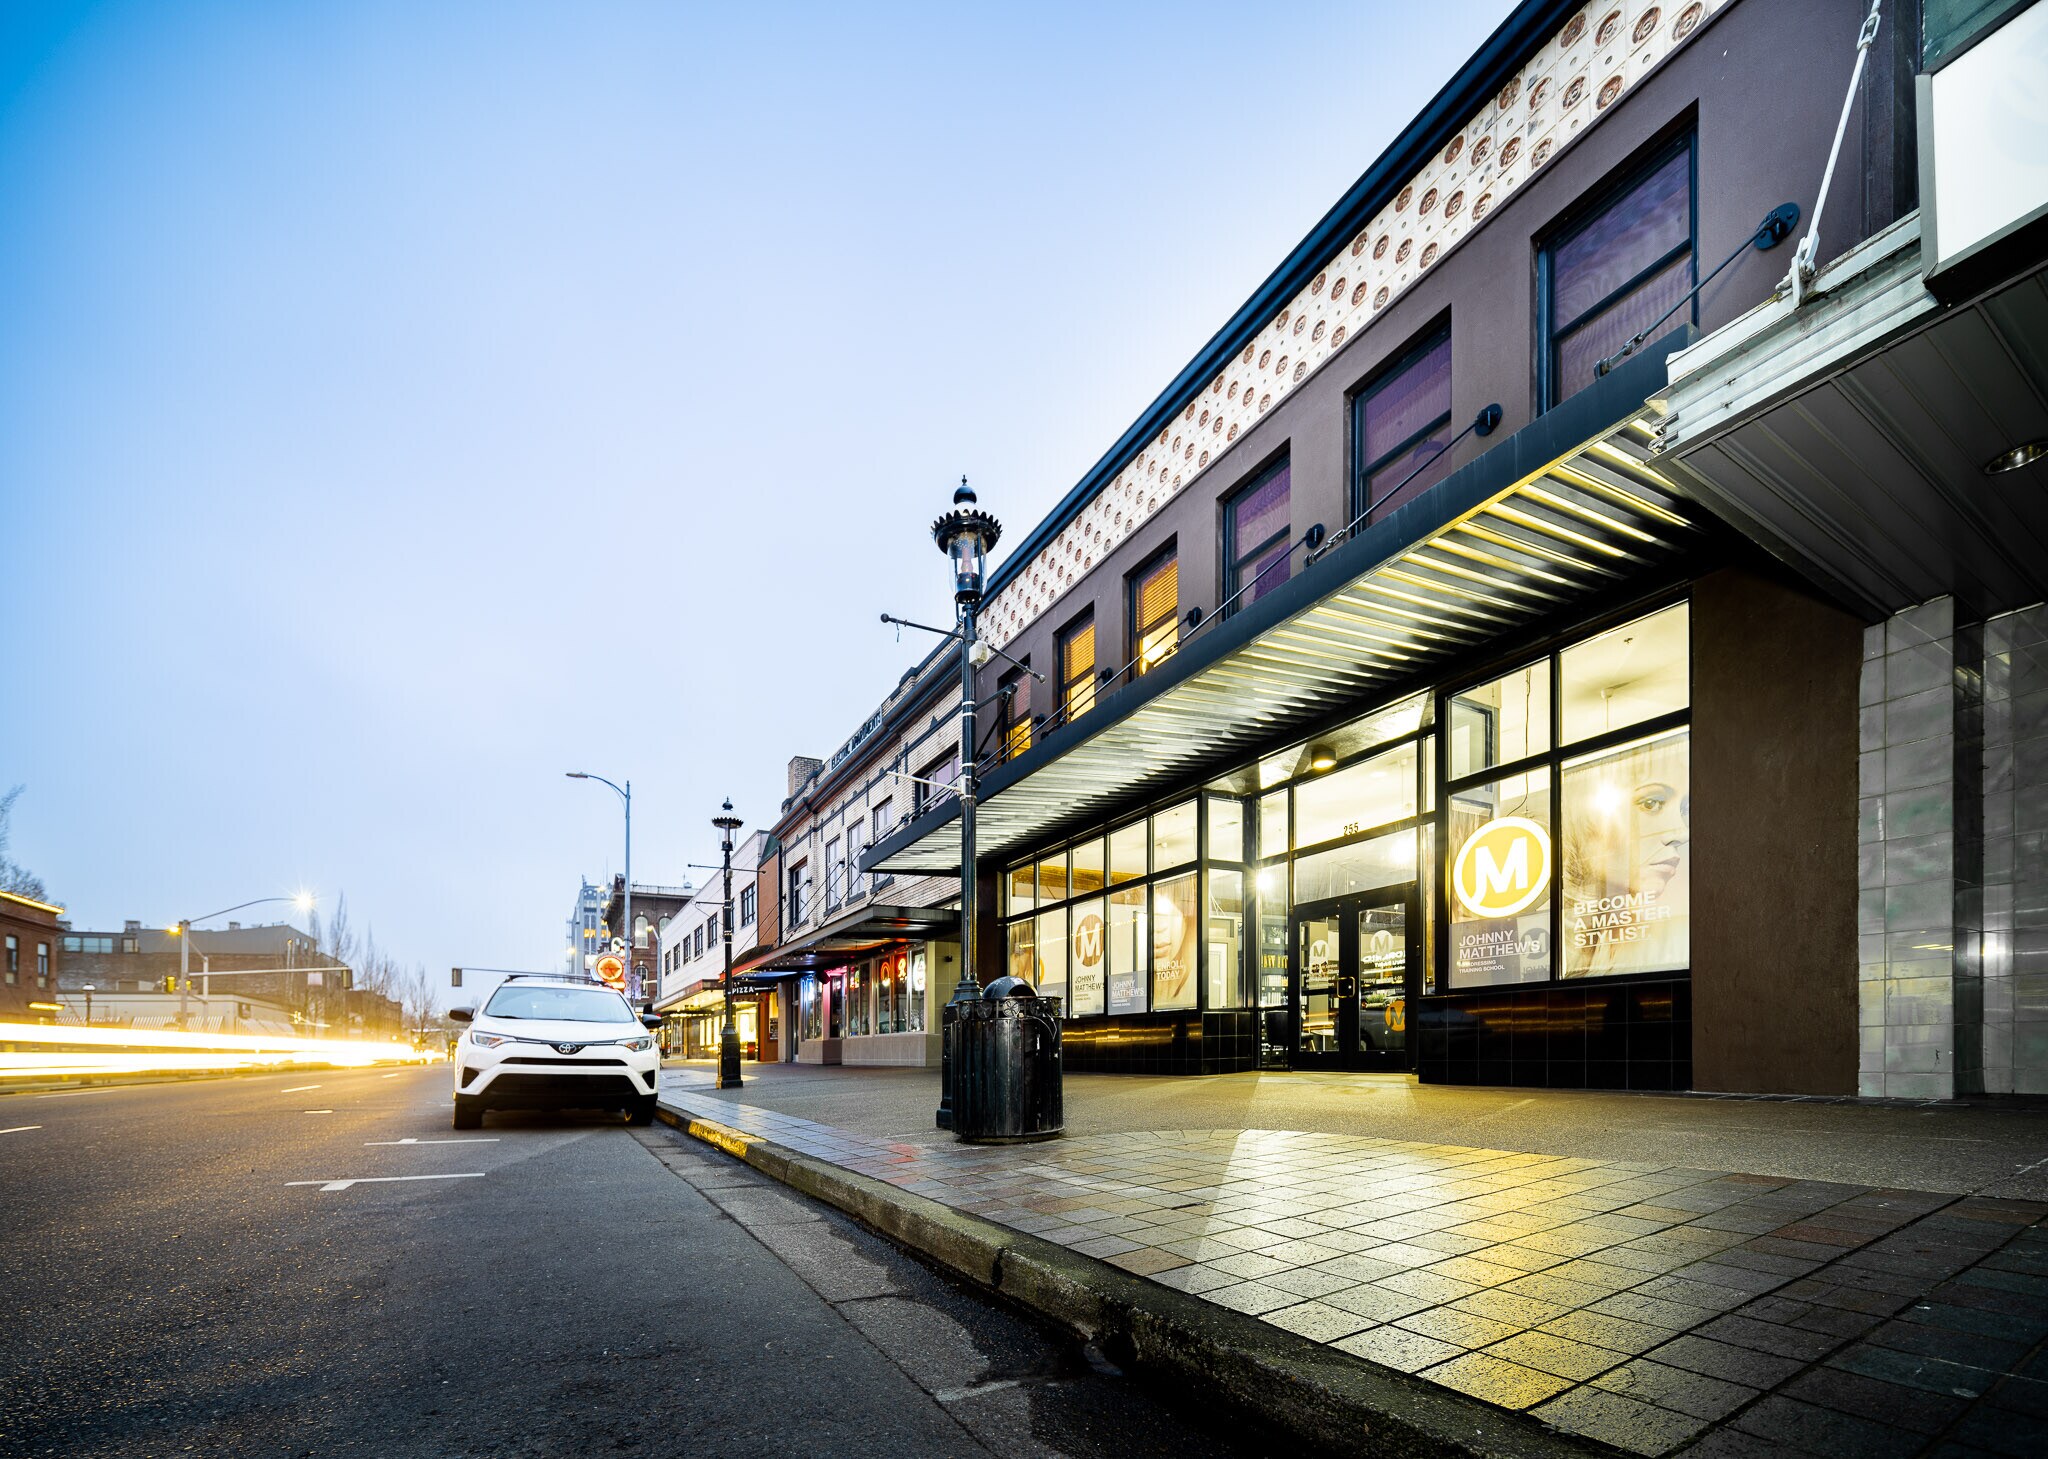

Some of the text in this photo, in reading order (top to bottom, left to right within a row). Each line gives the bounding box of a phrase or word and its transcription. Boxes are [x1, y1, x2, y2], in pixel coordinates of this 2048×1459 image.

[1343, 822, 1359, 836] 255
[1573, 890, 1656, 915] BECOME
[1573, 905, 1671, 932] A MASTER
[1458, 929, 1514, 947] JOHNNY
[1458, 940, 1541, 960] MATTHEW'S
[1458, 964, 1506, 974] TRAINING SCHOOL
[1075, 974, 1096, 984] JOHNNY
[1112, 979, 1136, 990] JOHNNY
[732, 986, 755, 995] PIZZA
